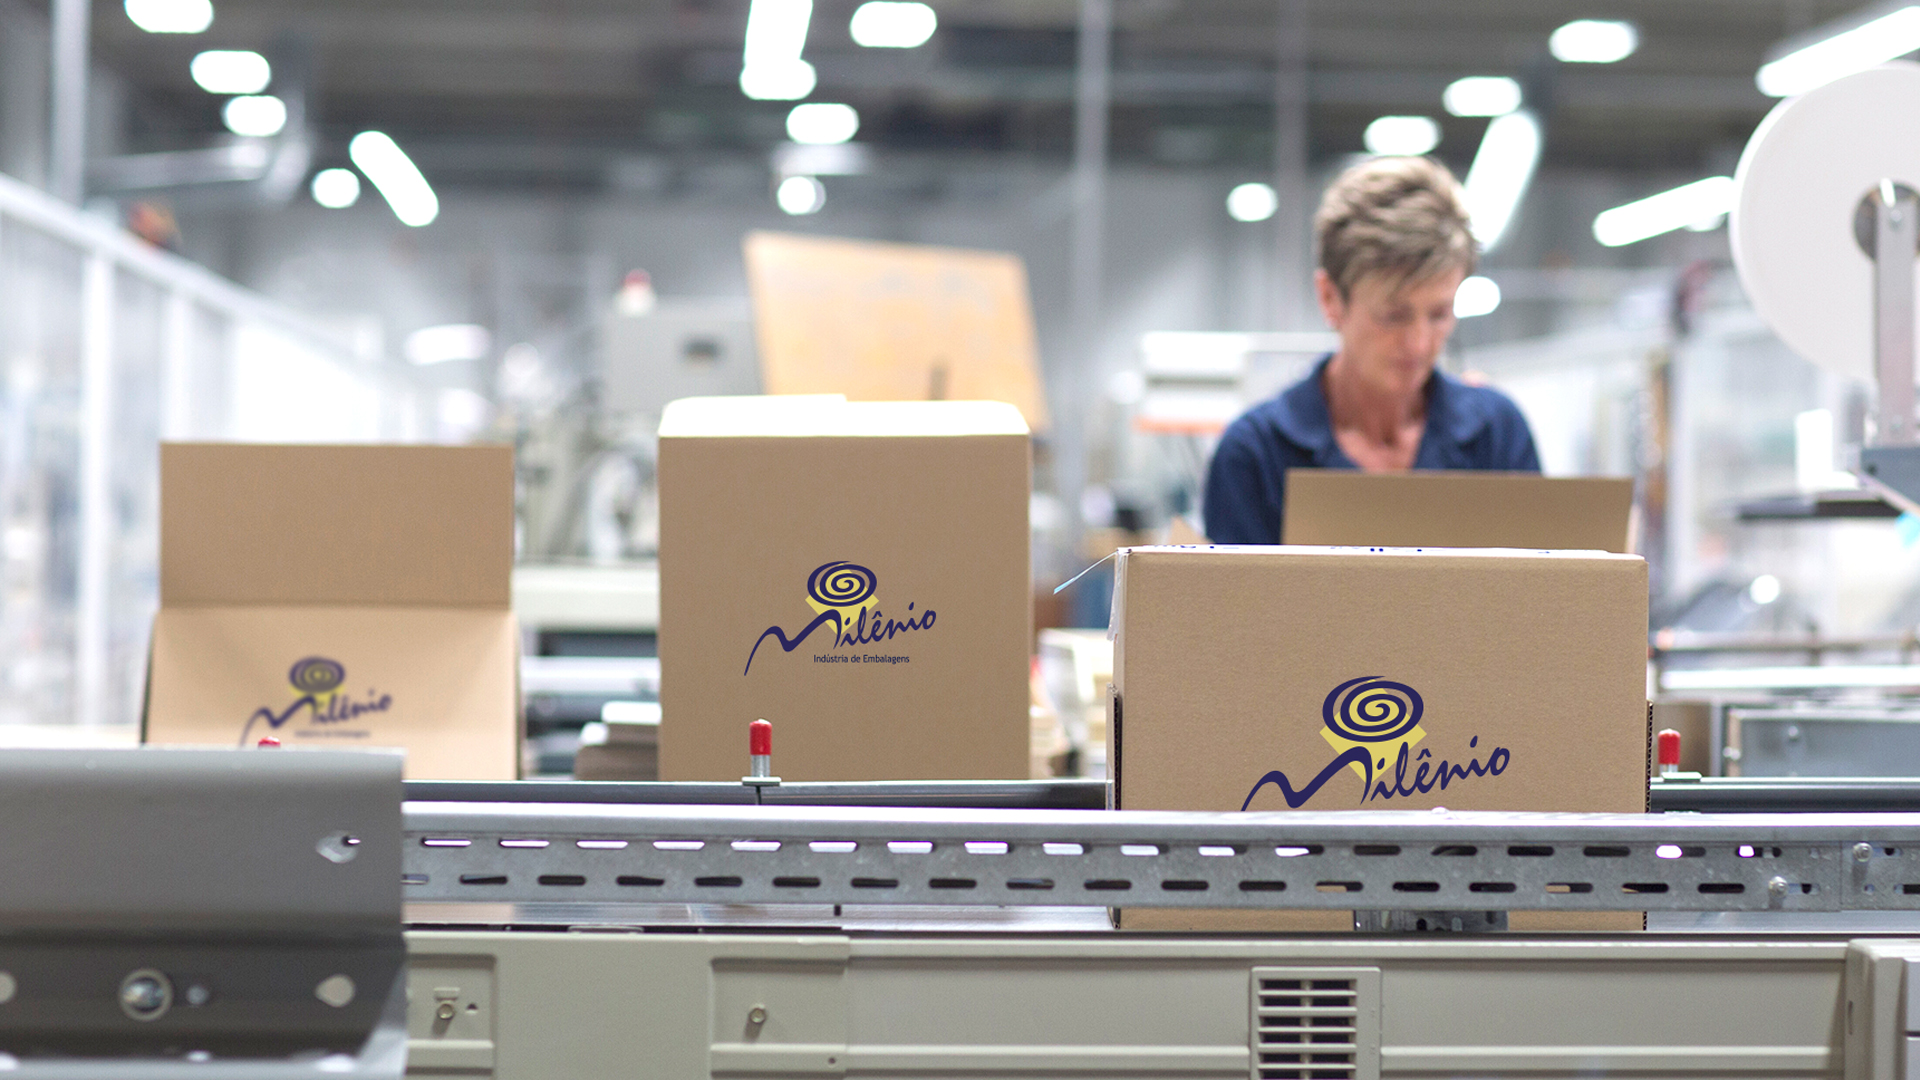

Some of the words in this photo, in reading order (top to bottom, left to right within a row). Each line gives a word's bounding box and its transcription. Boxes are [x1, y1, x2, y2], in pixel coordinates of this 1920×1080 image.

[744, 602, 937, 676] Milênio
[813, 654, 849, 663] Indústria
[850, 654, 861, 663] de
[862, 654, 910, 665] Embalagens
[1240, 736, 1510, 812] Milênio
